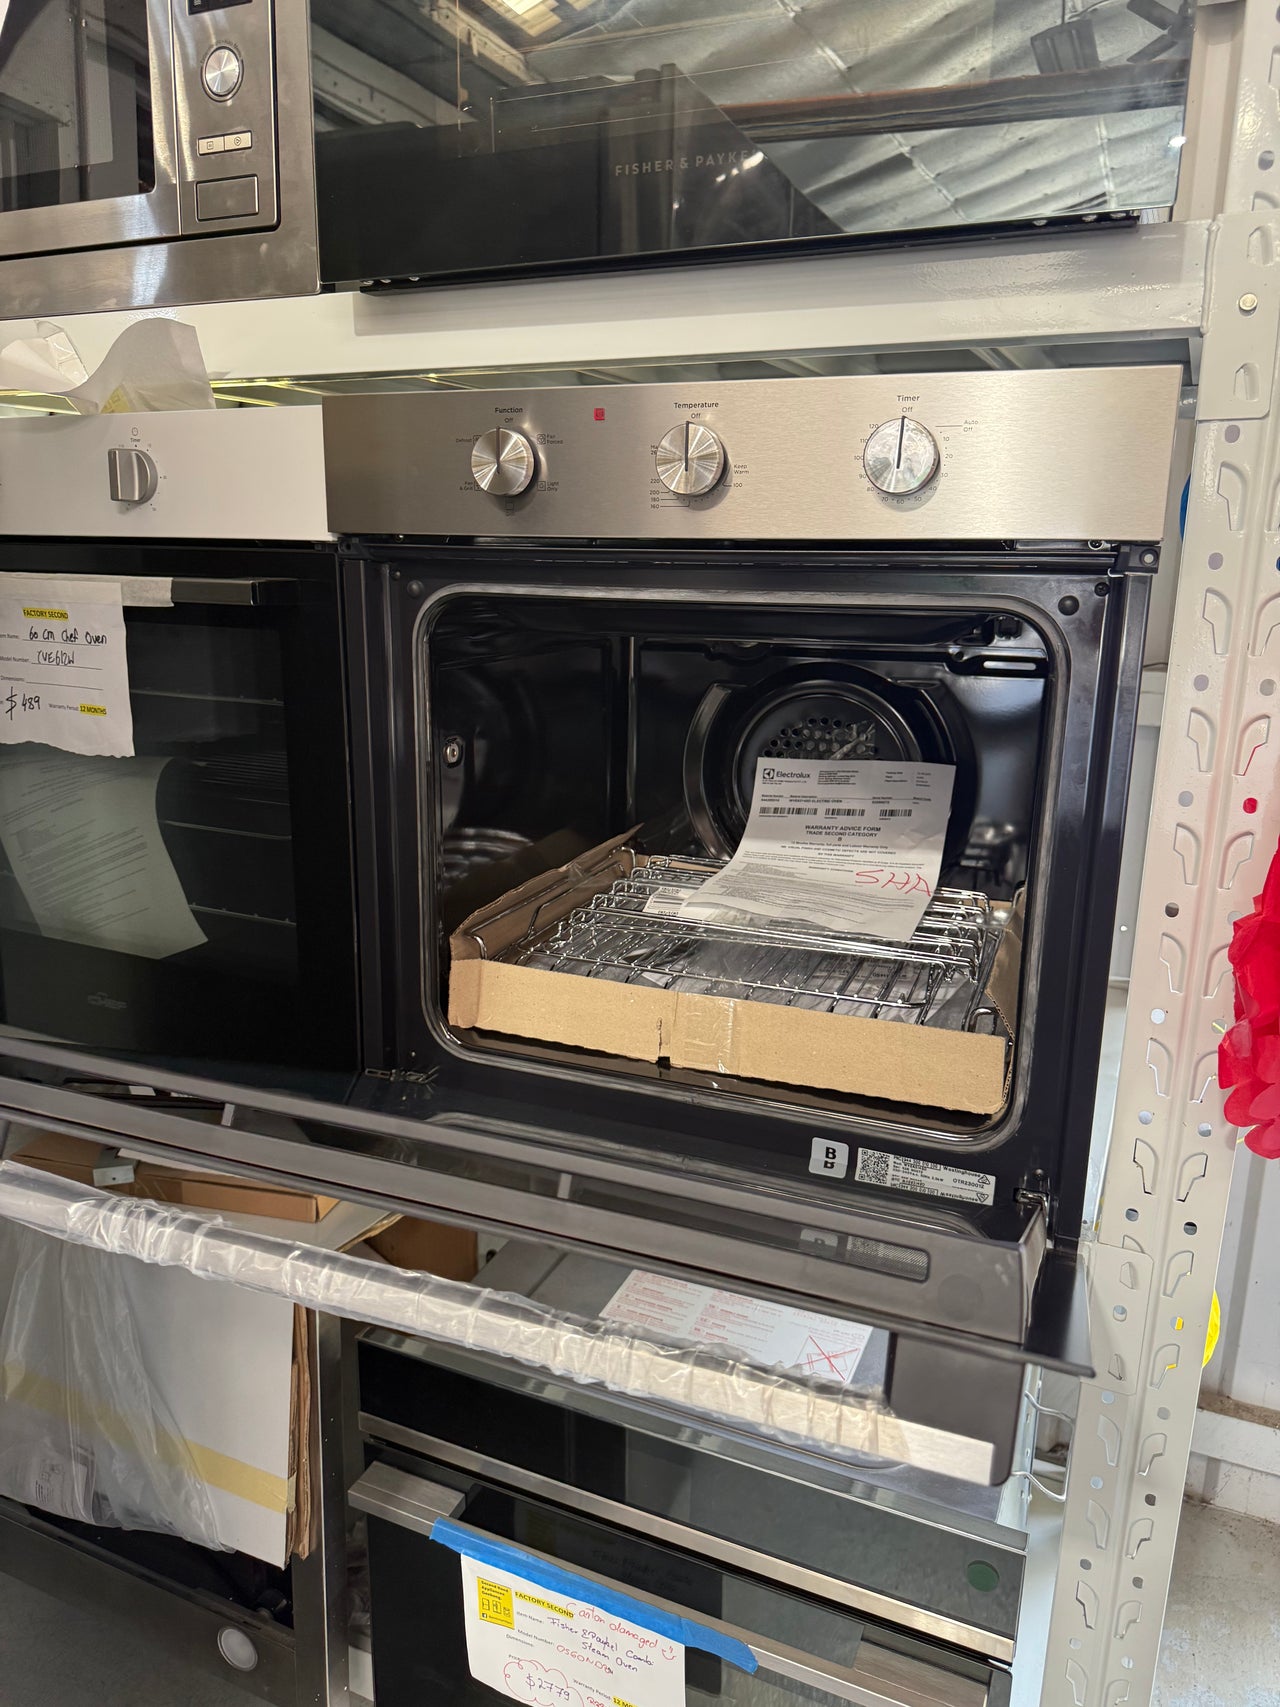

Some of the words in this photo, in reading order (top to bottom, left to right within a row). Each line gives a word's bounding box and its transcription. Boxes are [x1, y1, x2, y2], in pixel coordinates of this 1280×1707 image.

[615, 159, 674, 177] FISHER
[679, 156, 689, 169] &
[695, 150, 756, 167] PAYKE
[494, 406, 523, 414] Function
[23, 609, 47, 618] FACTORY
[48, 611, 69, 619] SECOND
[29, 625, 39, 640] 60
[61, 627, 79, 643] Chef
[85, 630, 107, 645] Oven
[86, 706, 107, 715] MONTHS
[776, 770, 811, 779] Electrolux
[824, 1146, 837, 1161] B
[943, 1165, 981, 1178] Westinghouse
[480, 1580, 497, 1589] Second
[481, 1585, 505, 1596] Appliances
[514, 1591, 546, 1606] FACTORY
[546, 1602, 574, 1619] SECOND
[547, 1616, 578, 1634] Fisher
[566, 1602, 605, 1624] Carton
[608, 1622, 658, 1649] damaged
[517, 1629, 533, 1639] Model
[581, 1641, 610, 1660] Steam
[615, 1656, 638, 1673] Oven
[573, 1678, 595, 1693] Warranty
[613, 1697, 621, 1706] 12
